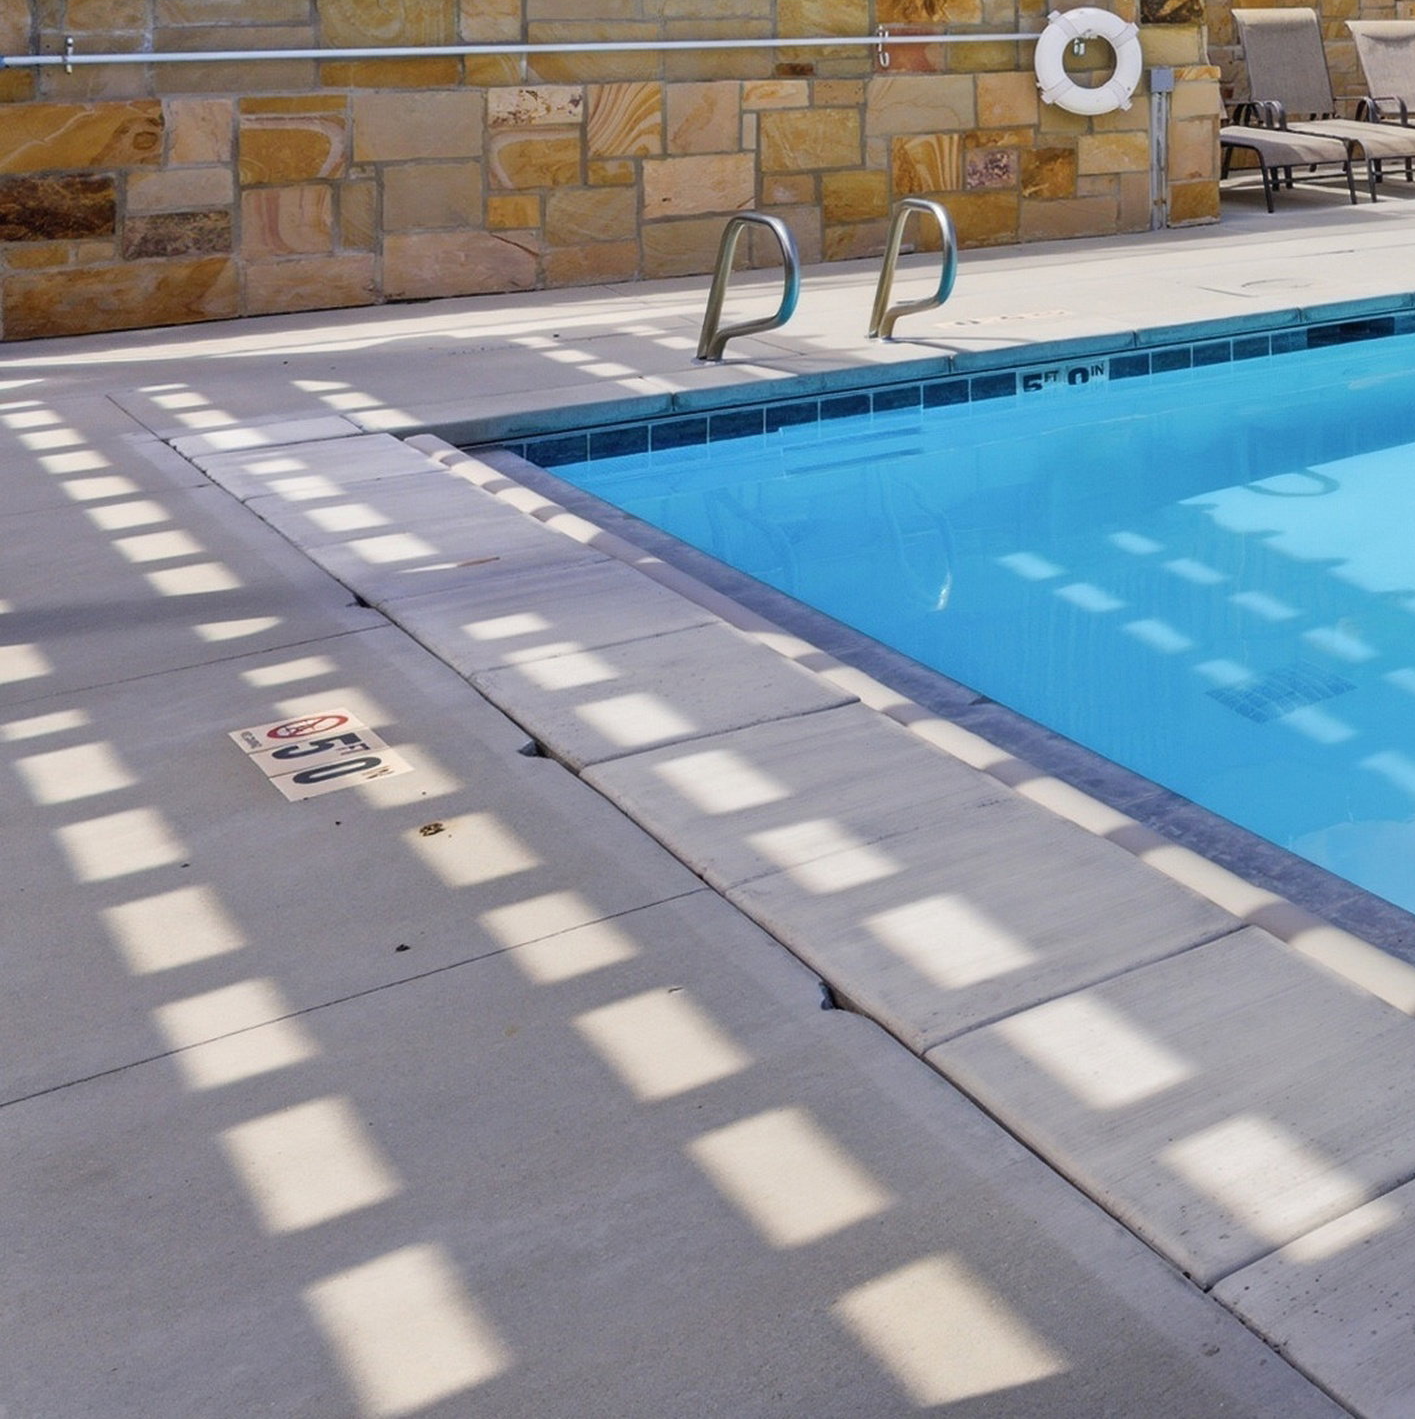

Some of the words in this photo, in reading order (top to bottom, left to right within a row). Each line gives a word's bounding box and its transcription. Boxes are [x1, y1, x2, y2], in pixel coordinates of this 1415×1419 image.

[1023, 373, 1043, 392] 5
[1091, 363, 1104, 376] IN
[271, 732, 362, 759] 5
[292, 756, 382, 784] 0
